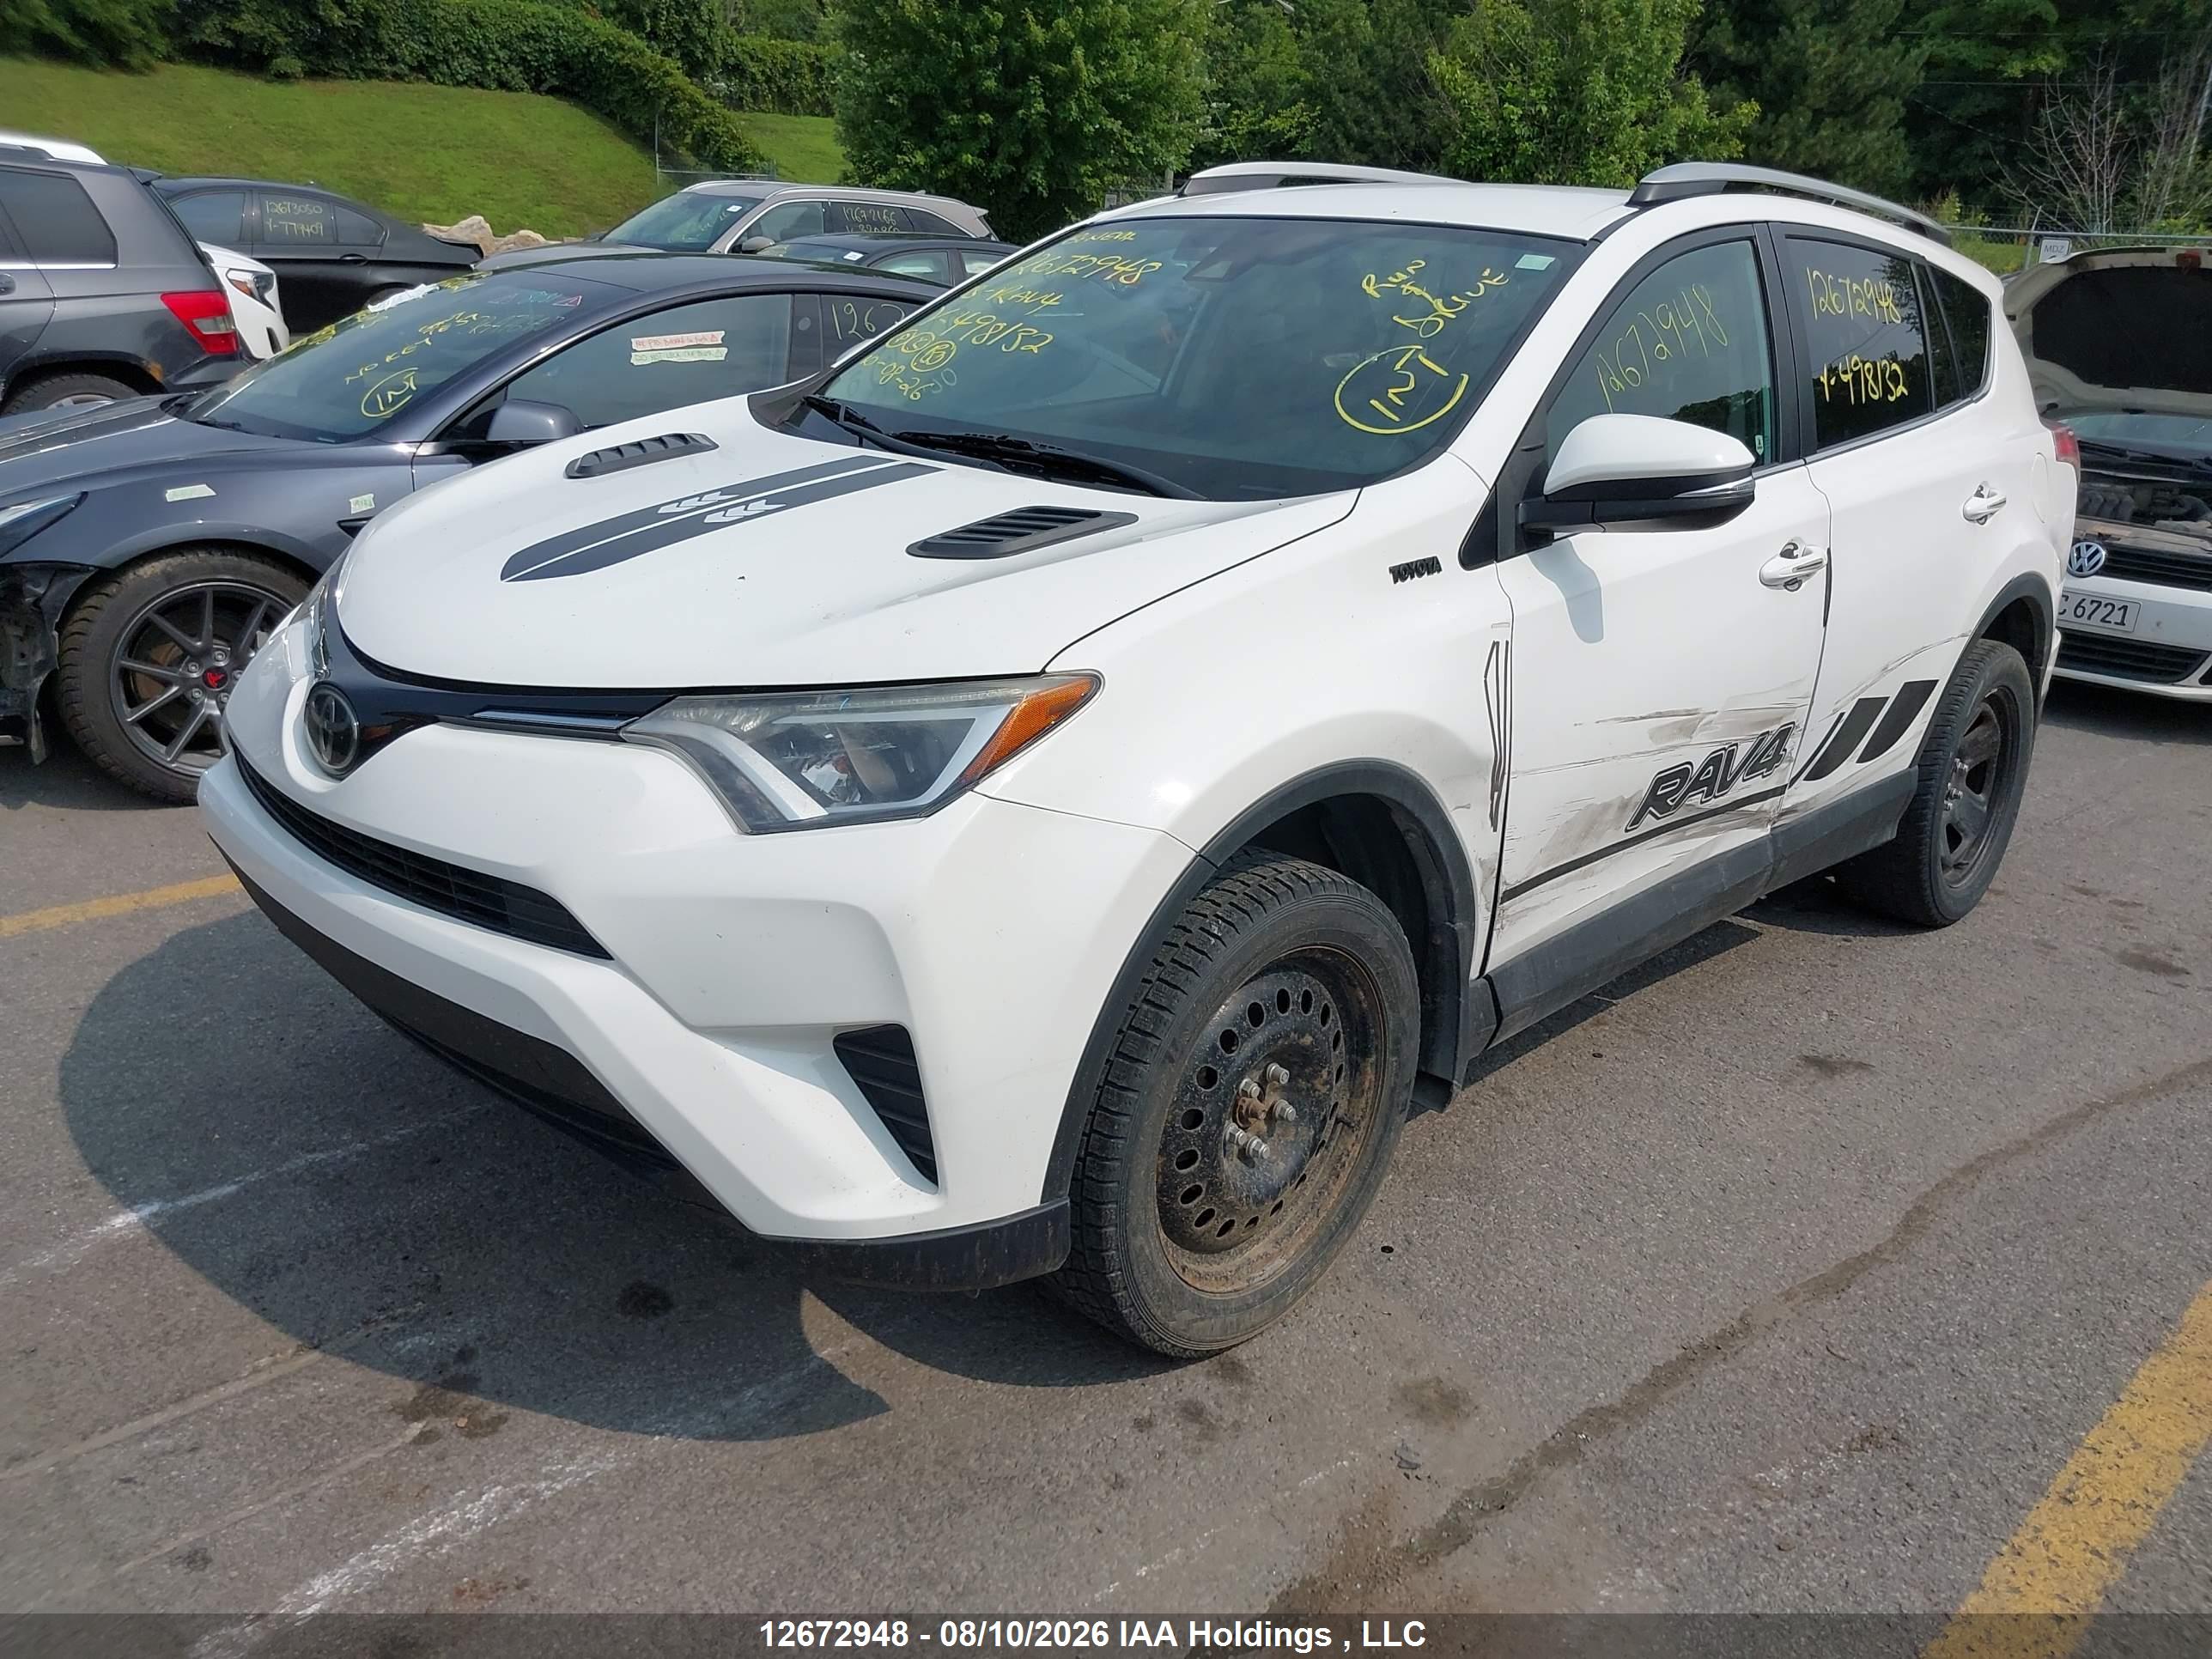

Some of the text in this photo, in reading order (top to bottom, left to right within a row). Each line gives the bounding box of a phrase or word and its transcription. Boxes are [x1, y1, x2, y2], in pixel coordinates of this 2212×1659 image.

[1807, 266, 1901, 325] 12672948
[1596, 283, 1728, 414] 12672948
[1389, 556, 1443, 584] TOYOTA
[2073, 598, 2129, 626] 6721
[1625, 720, 1796, 833] RAV4
